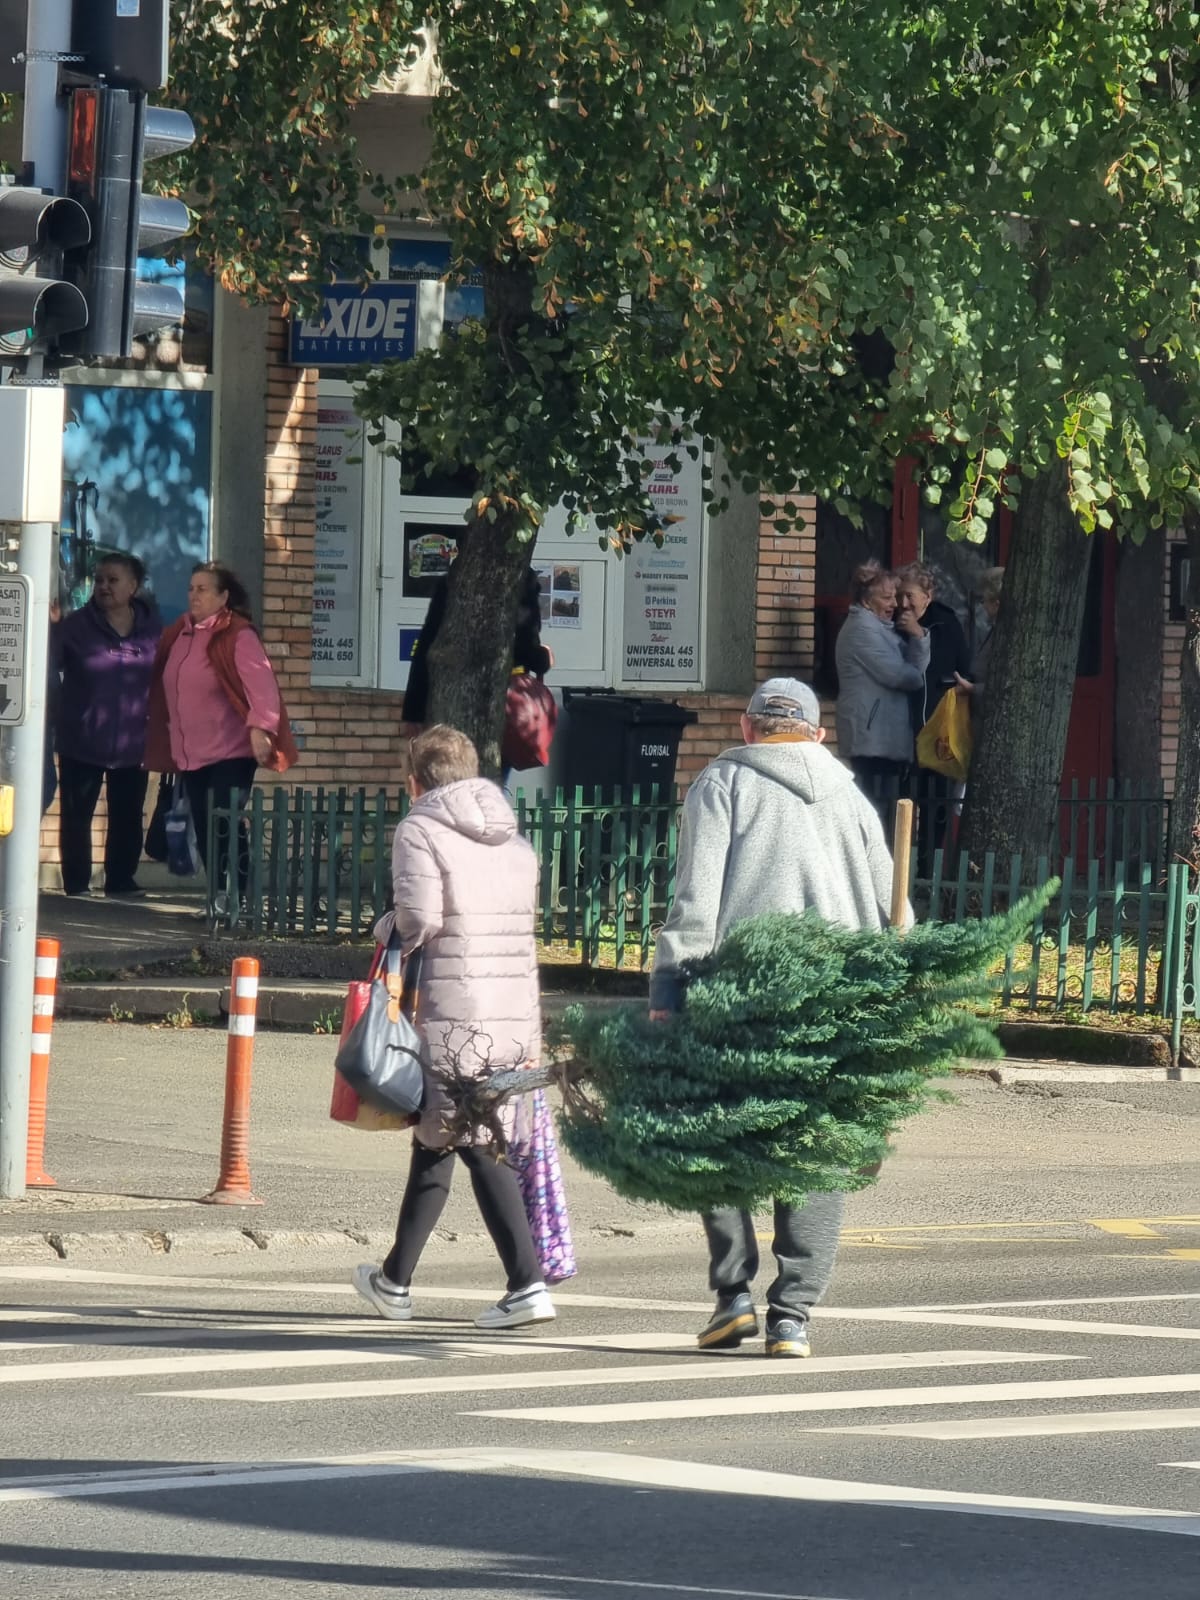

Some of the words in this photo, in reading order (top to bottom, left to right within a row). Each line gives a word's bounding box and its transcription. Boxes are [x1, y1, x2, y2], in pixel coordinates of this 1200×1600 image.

[298, 341, 405, 352] BATTERIES
[647, 484, 679, 494] CLAAS
[322, 523, 347, 533] DEERE
[665, 534, 688, 544] DEERE
[652, 596, 677, 605] Perkins
[645, 608, 676, 618] STEYR
[336, 638, 354, 649] 445
[627, 645, 675, 656] UNIVERSAL
[677, 646, 694, 656] 445
[336, 651, 354, 661] 650
[627, 657, 675, 668] UNIVERSAL
[677, 658, 694, 668] 650
[641, 744, 670, 756] FLORISAL
